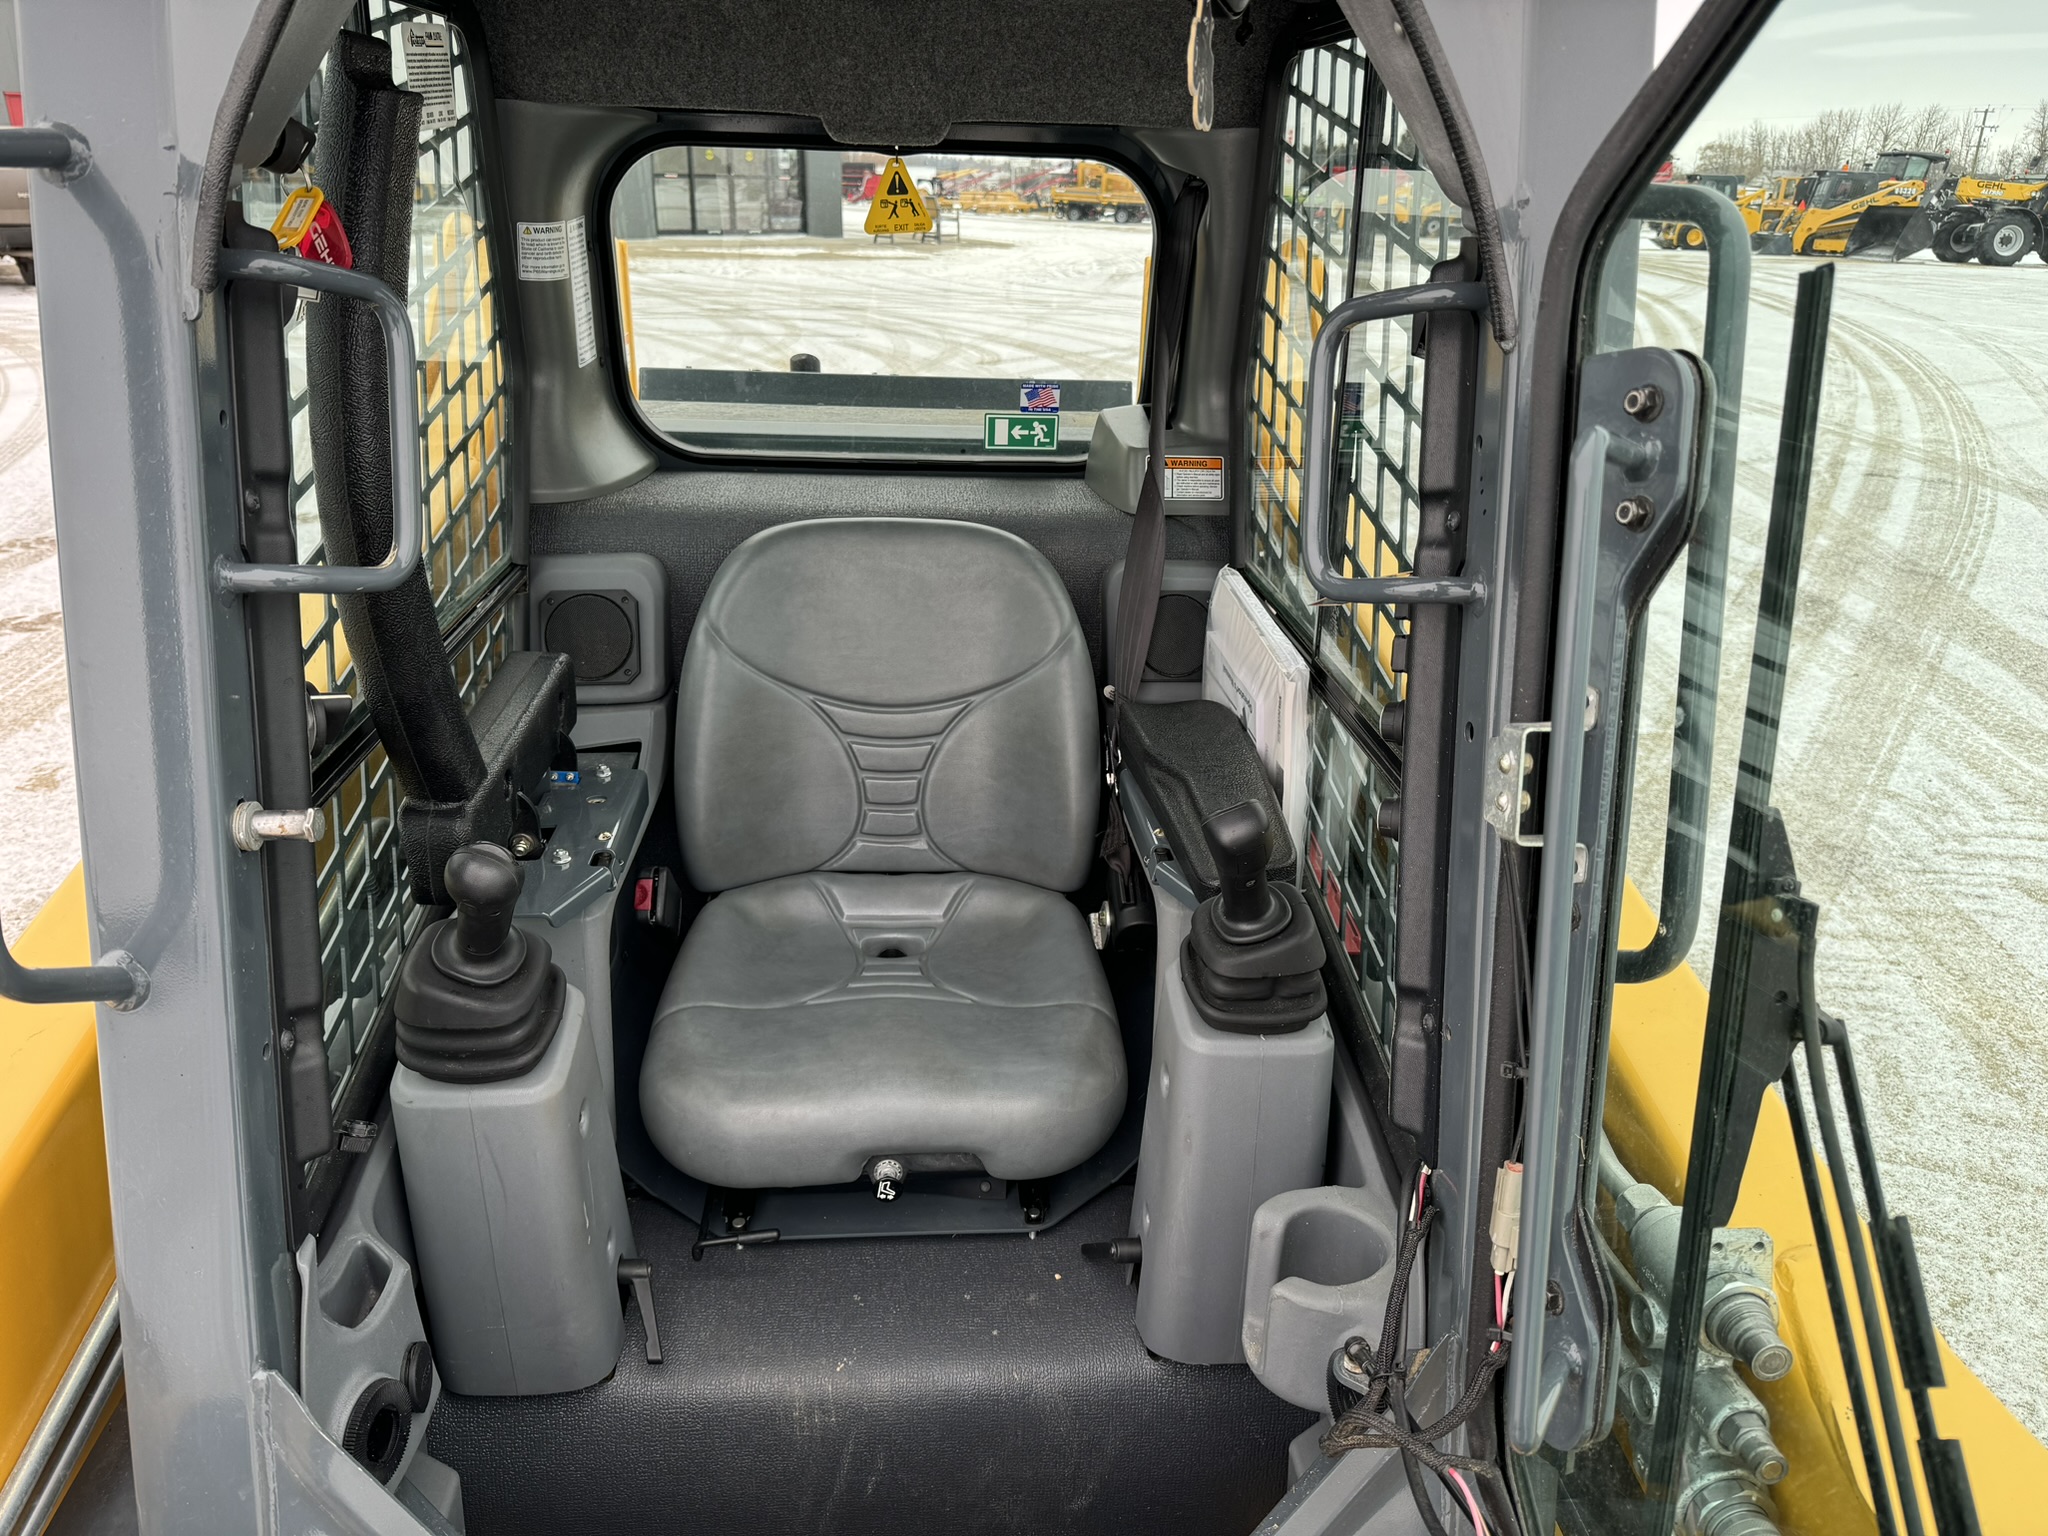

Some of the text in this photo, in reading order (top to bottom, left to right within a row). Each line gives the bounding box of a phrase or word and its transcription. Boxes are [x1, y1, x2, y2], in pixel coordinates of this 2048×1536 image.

[1977, 181, 2006, 191] GEHL
[1851, 197, 1879, 210] GEHL
[532, 226, 563, 234] WARNING
[894, 224, 909, 232] EXIT
[309, 221, 335, 265] GEH
